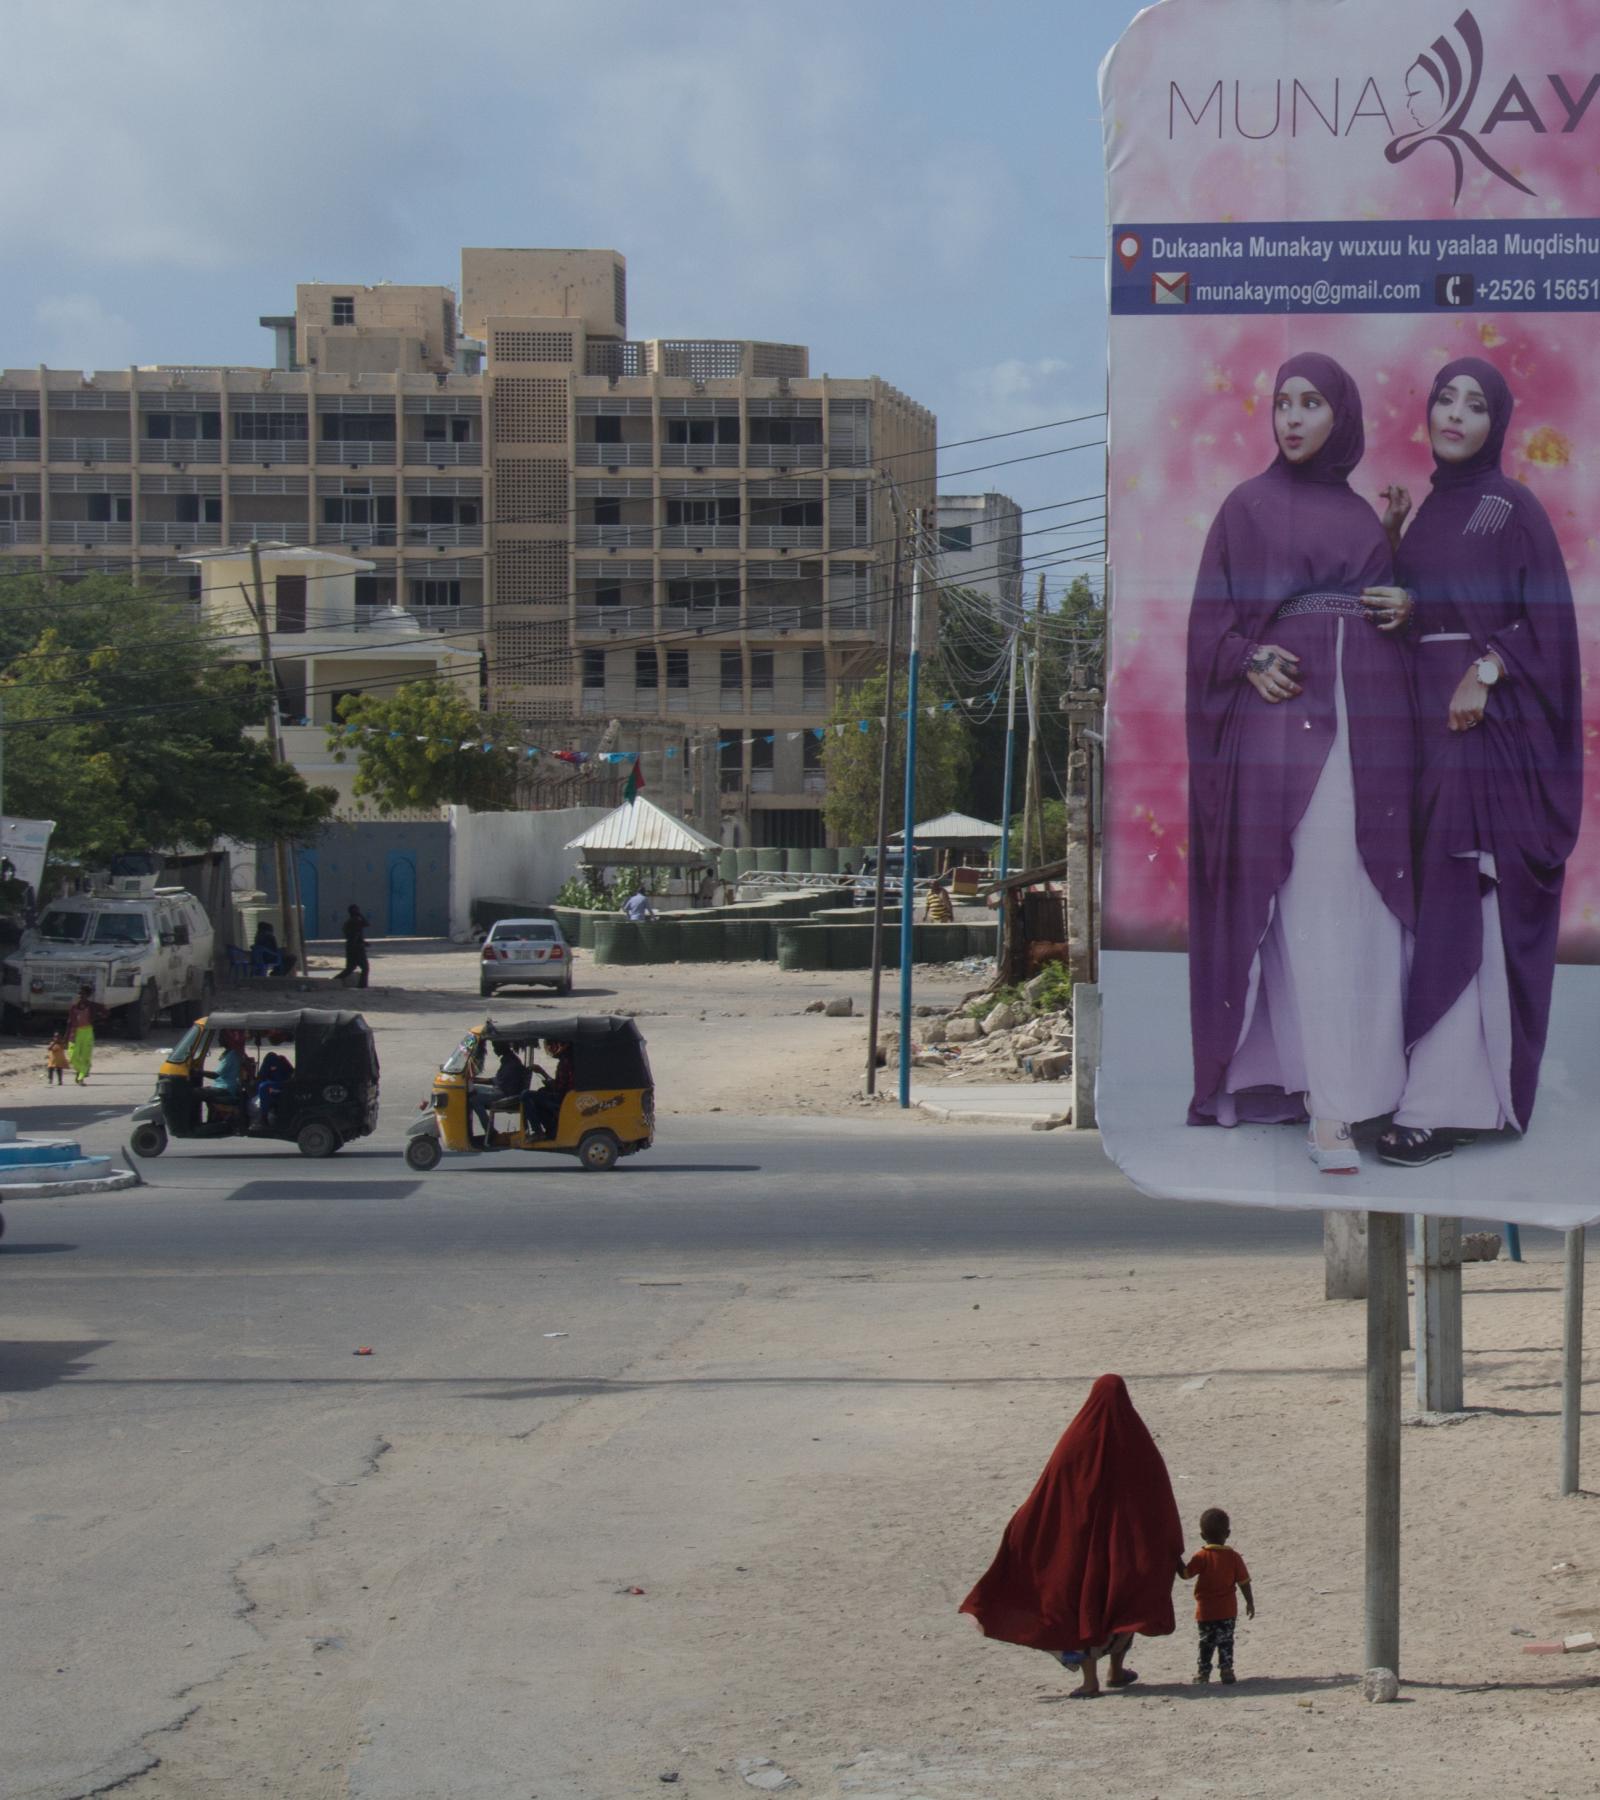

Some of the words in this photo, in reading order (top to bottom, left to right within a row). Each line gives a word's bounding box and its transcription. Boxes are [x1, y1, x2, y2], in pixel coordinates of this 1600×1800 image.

[1151, 237, 1243, 258] Dukaanka
[1249, 236, 1333, 262] Munakay
[1339, 239, 1401, 256] wuxuu
[1408, 235, 1431, 255] ku
[1436, 235, 1498, 260] yaalaa
[1504, 233, 1600, 260] Muqdishu
[1196, 280, 1420, 305] munakaymog@gmail.com
[1476, 279, 1536, 300] +2526
